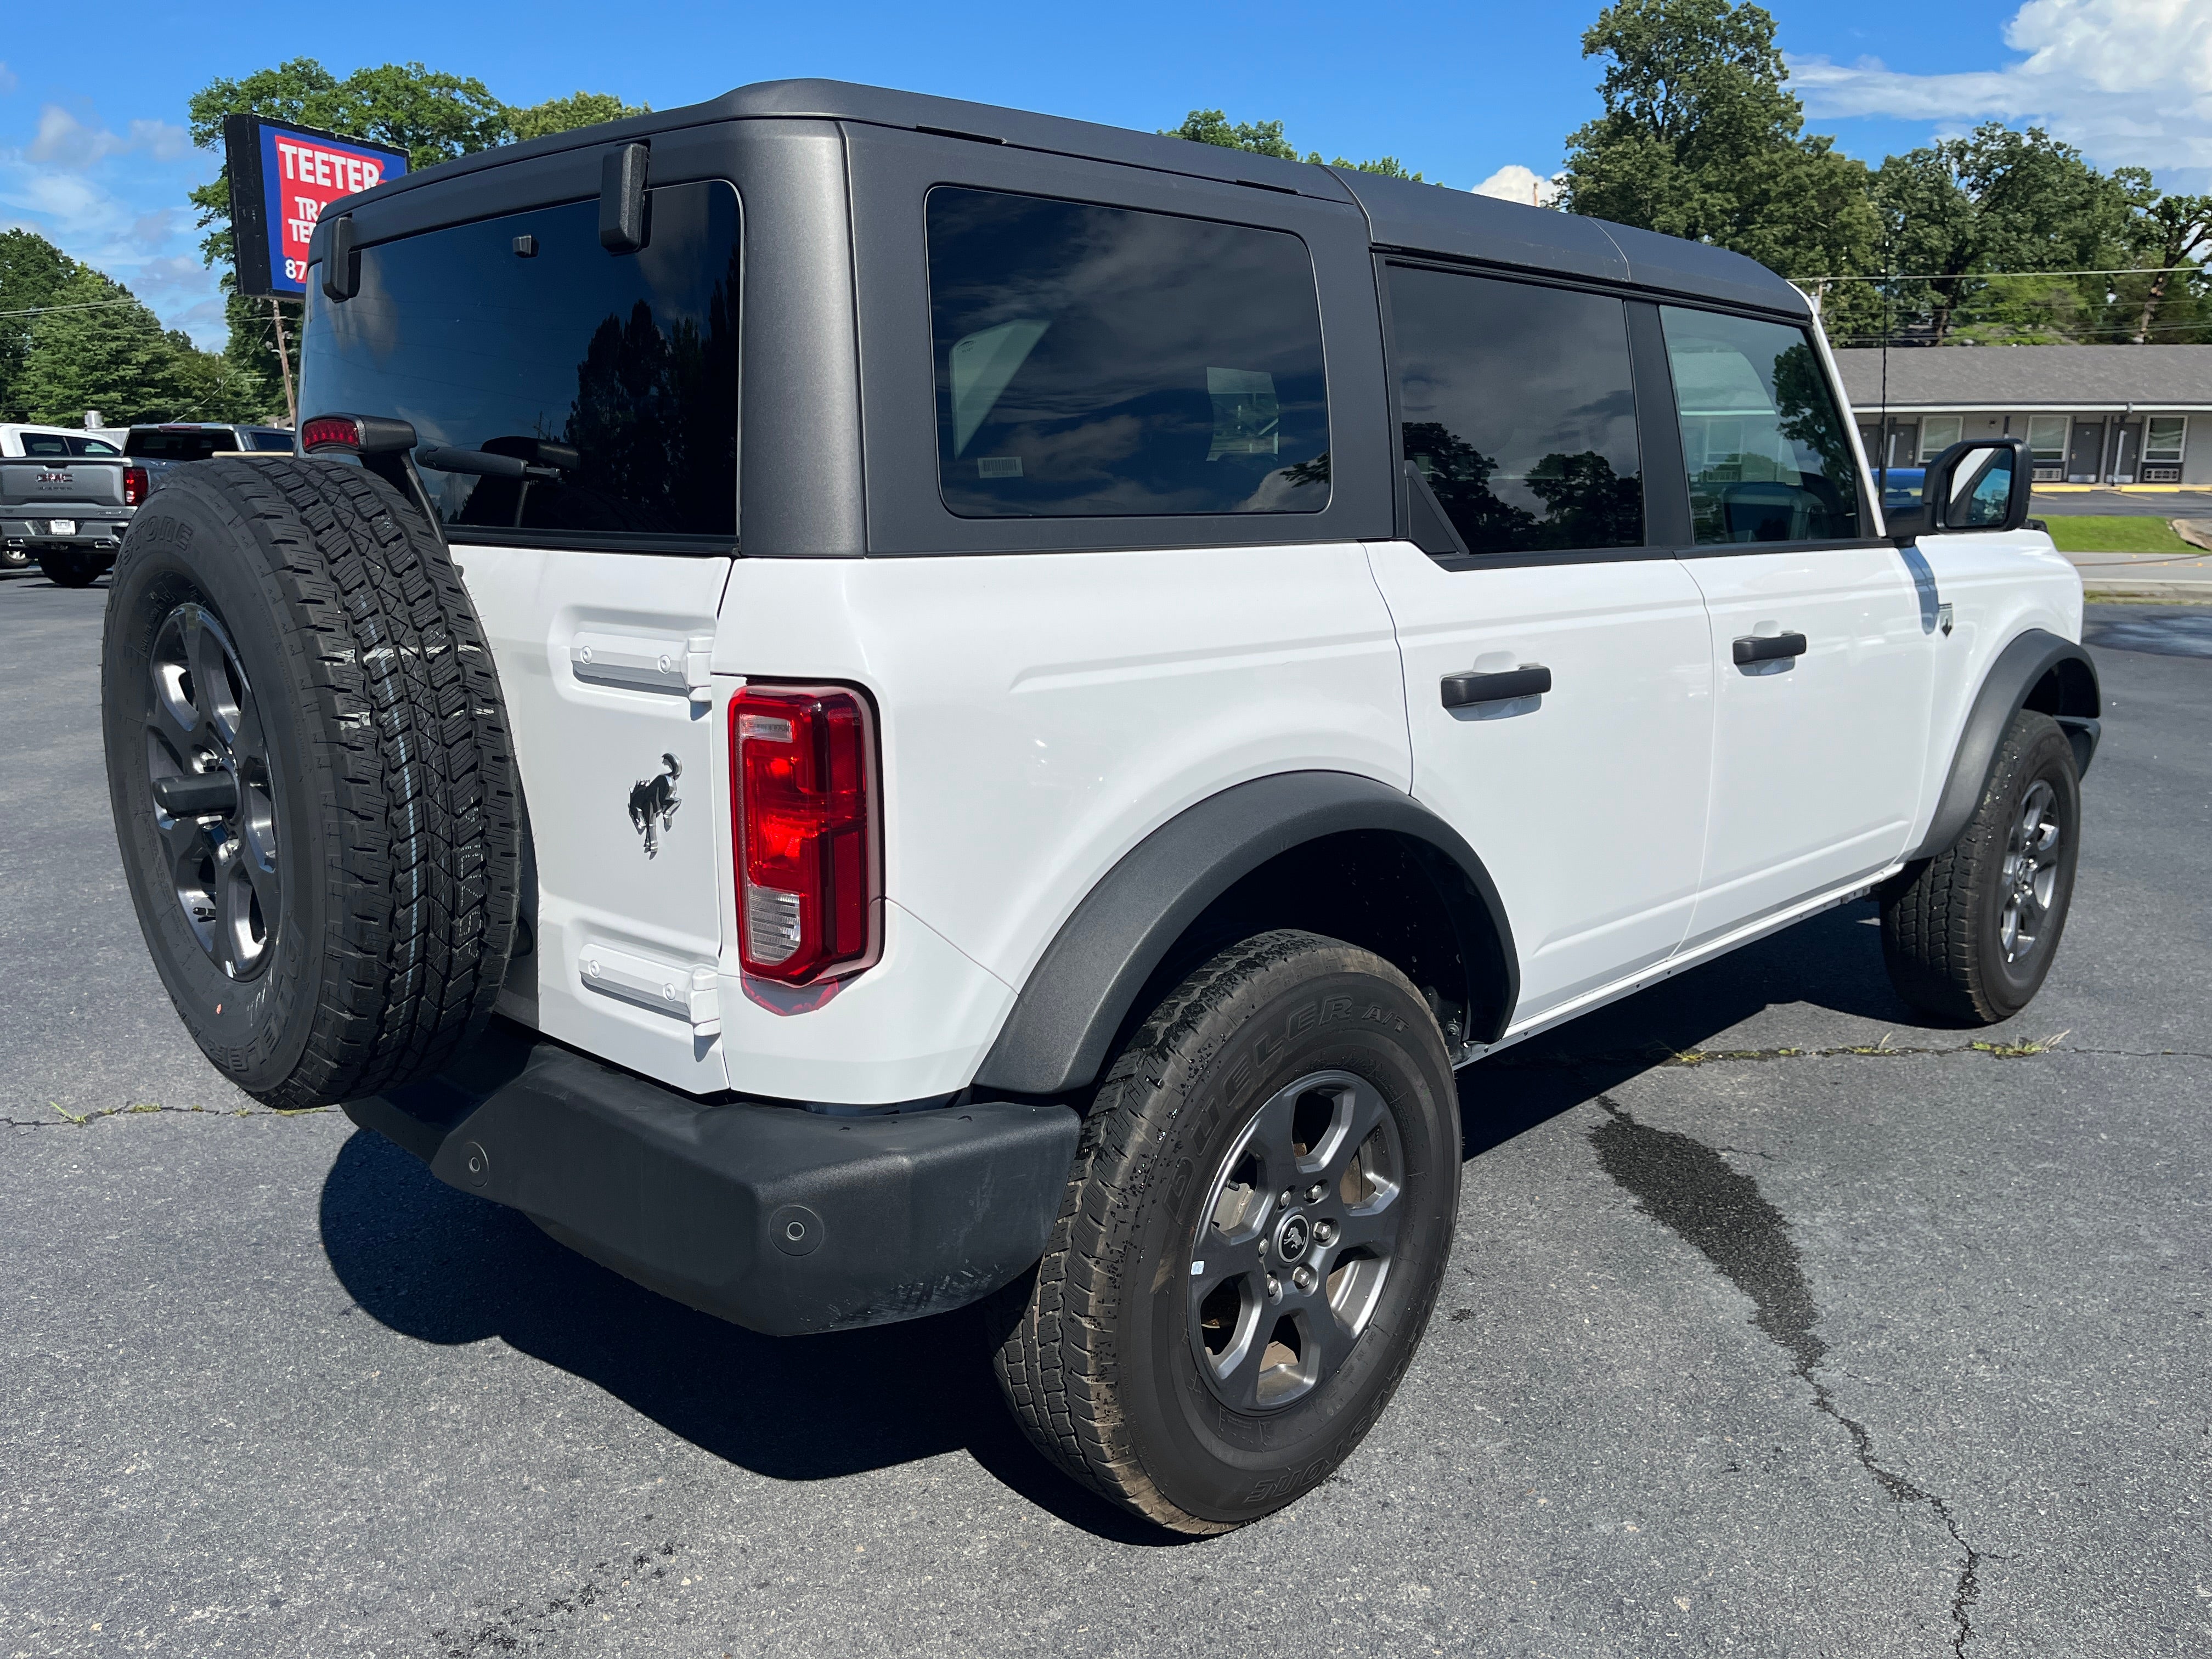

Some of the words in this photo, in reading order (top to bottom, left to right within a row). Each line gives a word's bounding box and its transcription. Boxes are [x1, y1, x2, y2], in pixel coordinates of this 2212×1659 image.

[279, 143, 380, 193] TEETER
[285, 258, 307, 280] 87
[36, 473, 74, 483] GMC
[1152, 994, 1355, 1225] DUELER
[1362, 1003, 1410, 1034] A/T
